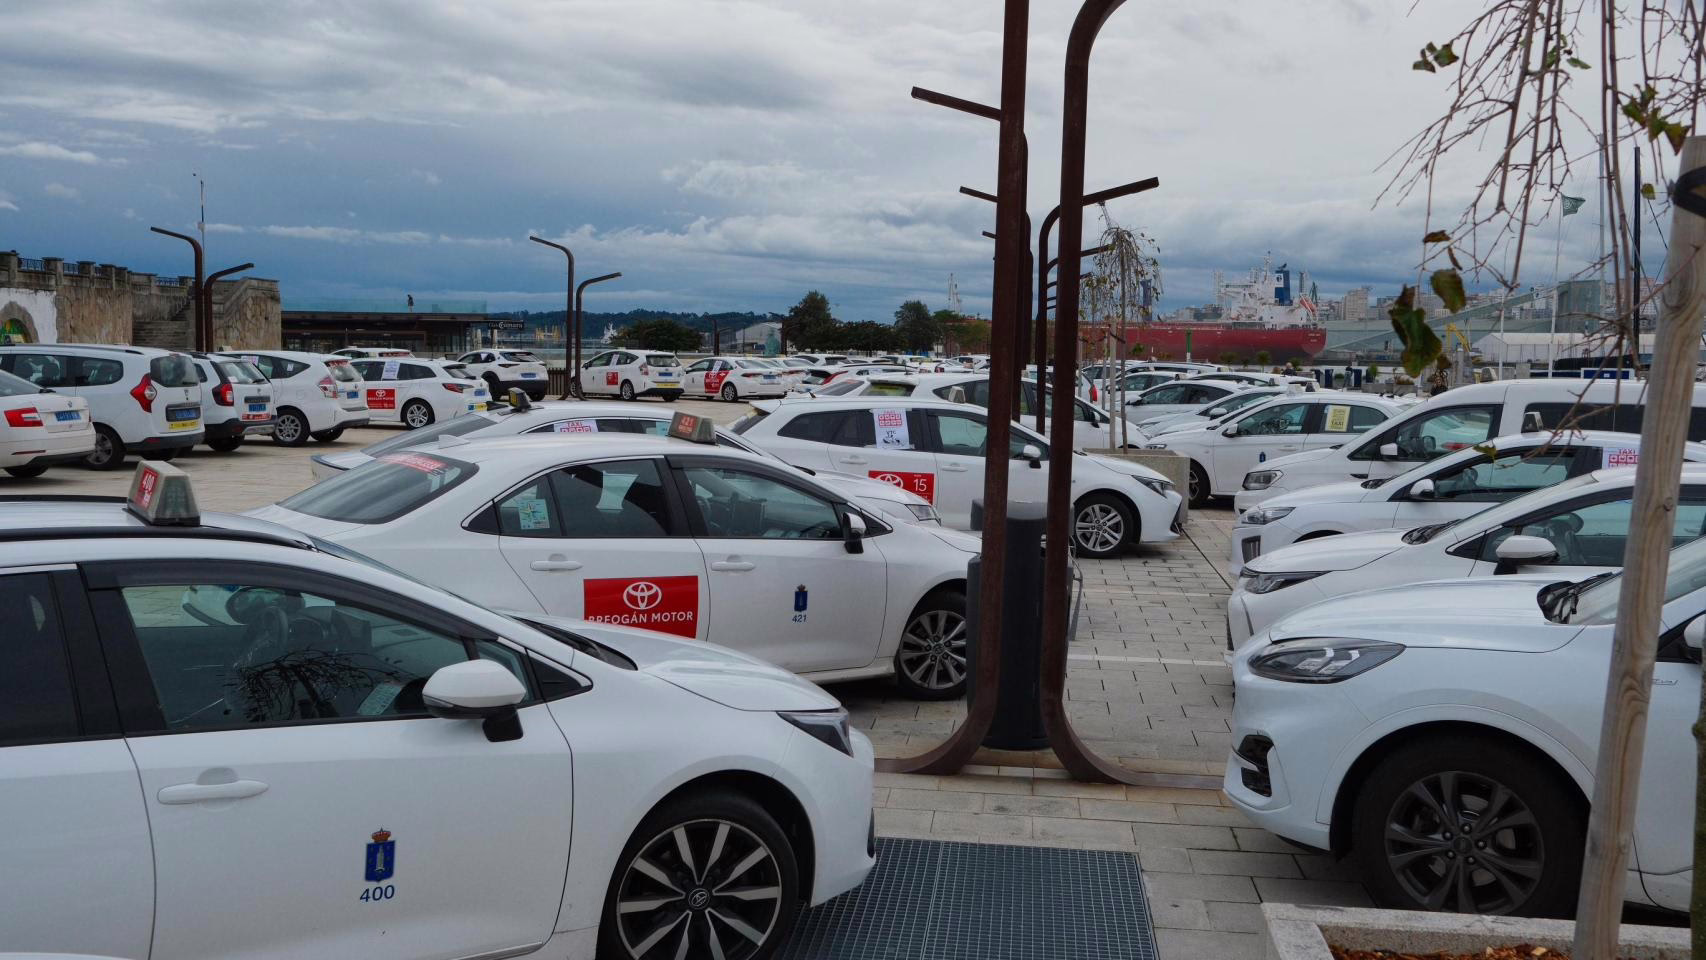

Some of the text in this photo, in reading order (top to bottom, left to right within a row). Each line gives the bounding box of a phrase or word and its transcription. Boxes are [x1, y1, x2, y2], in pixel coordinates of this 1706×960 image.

[142, 472, 155, 492] 400
[913, 478, 927, 492] 15
[651, 611, 694, 623] MOTOR
[791, 614, 807, 623] 421
[359, 884, 395, 903] 400
